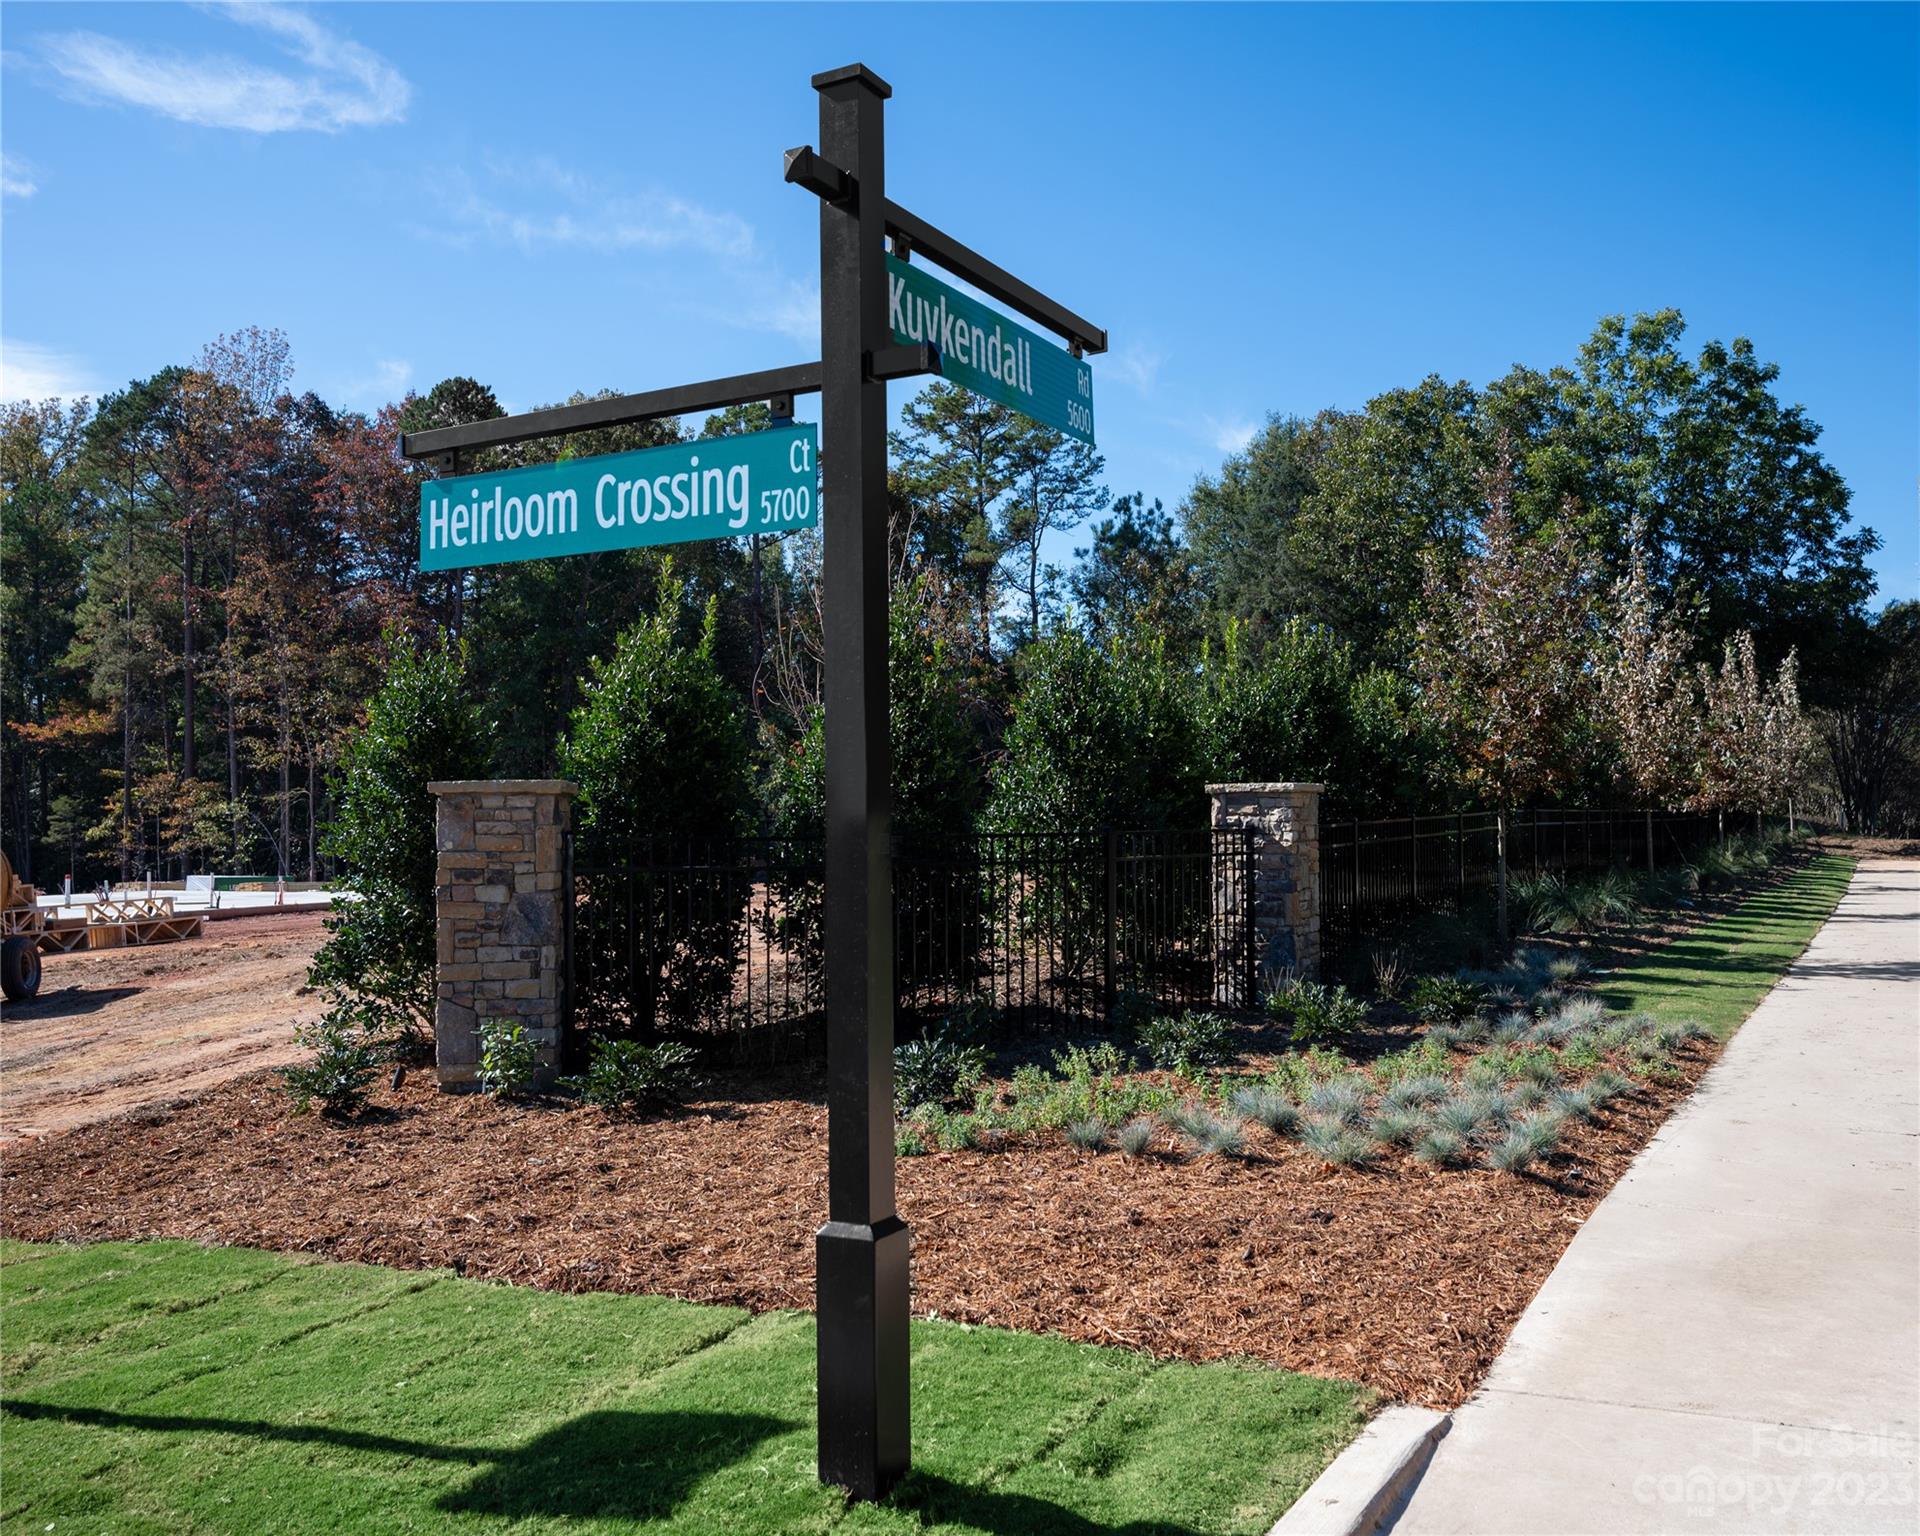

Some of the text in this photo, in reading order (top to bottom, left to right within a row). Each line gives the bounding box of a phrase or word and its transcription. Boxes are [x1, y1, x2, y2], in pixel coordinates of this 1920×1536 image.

[888, 272, 1090, 398] Kuykendall Rd
[1067, 400, 1091, 434] 5600
[429, 439, 810, 550] Heirloom Crossing Ct
[760, 486, 810, 524] 5700
